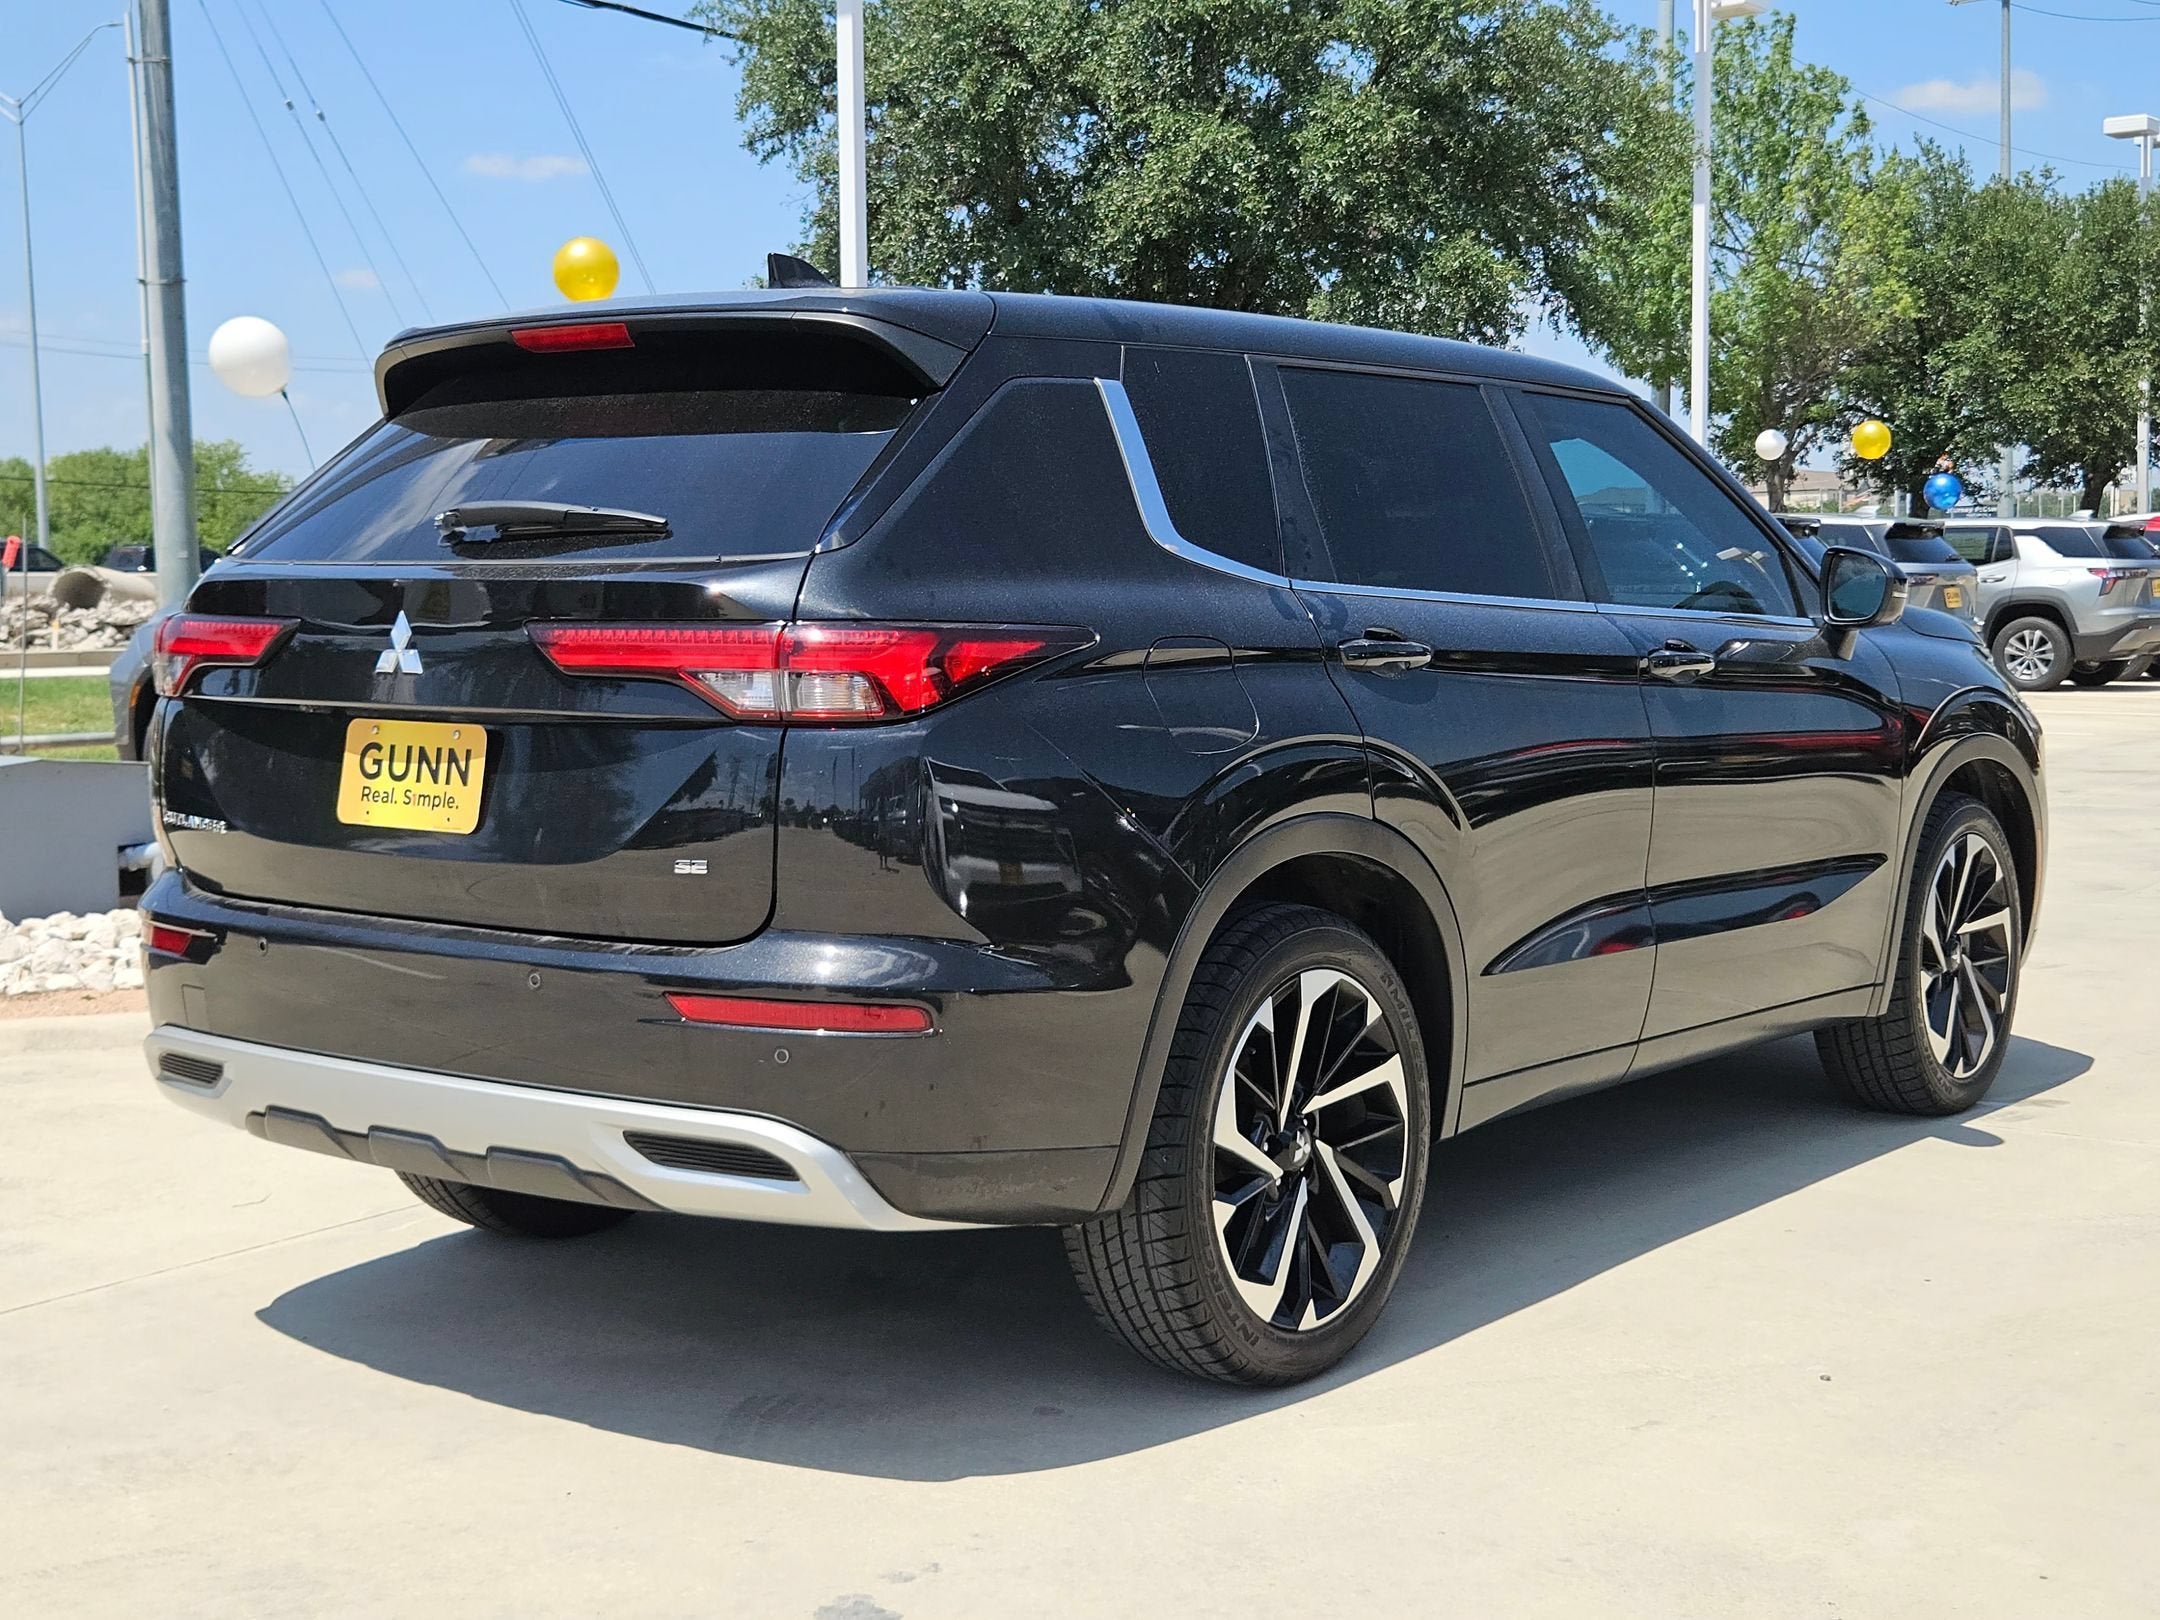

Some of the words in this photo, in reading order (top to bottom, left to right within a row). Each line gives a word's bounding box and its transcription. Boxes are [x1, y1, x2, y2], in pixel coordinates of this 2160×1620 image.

[359, 741, 472, 787] GUNN
[361, 785, 397, 804] Real.
[402, 789, 459, 811] Simple.
[674, 859, 708, 874] SE
